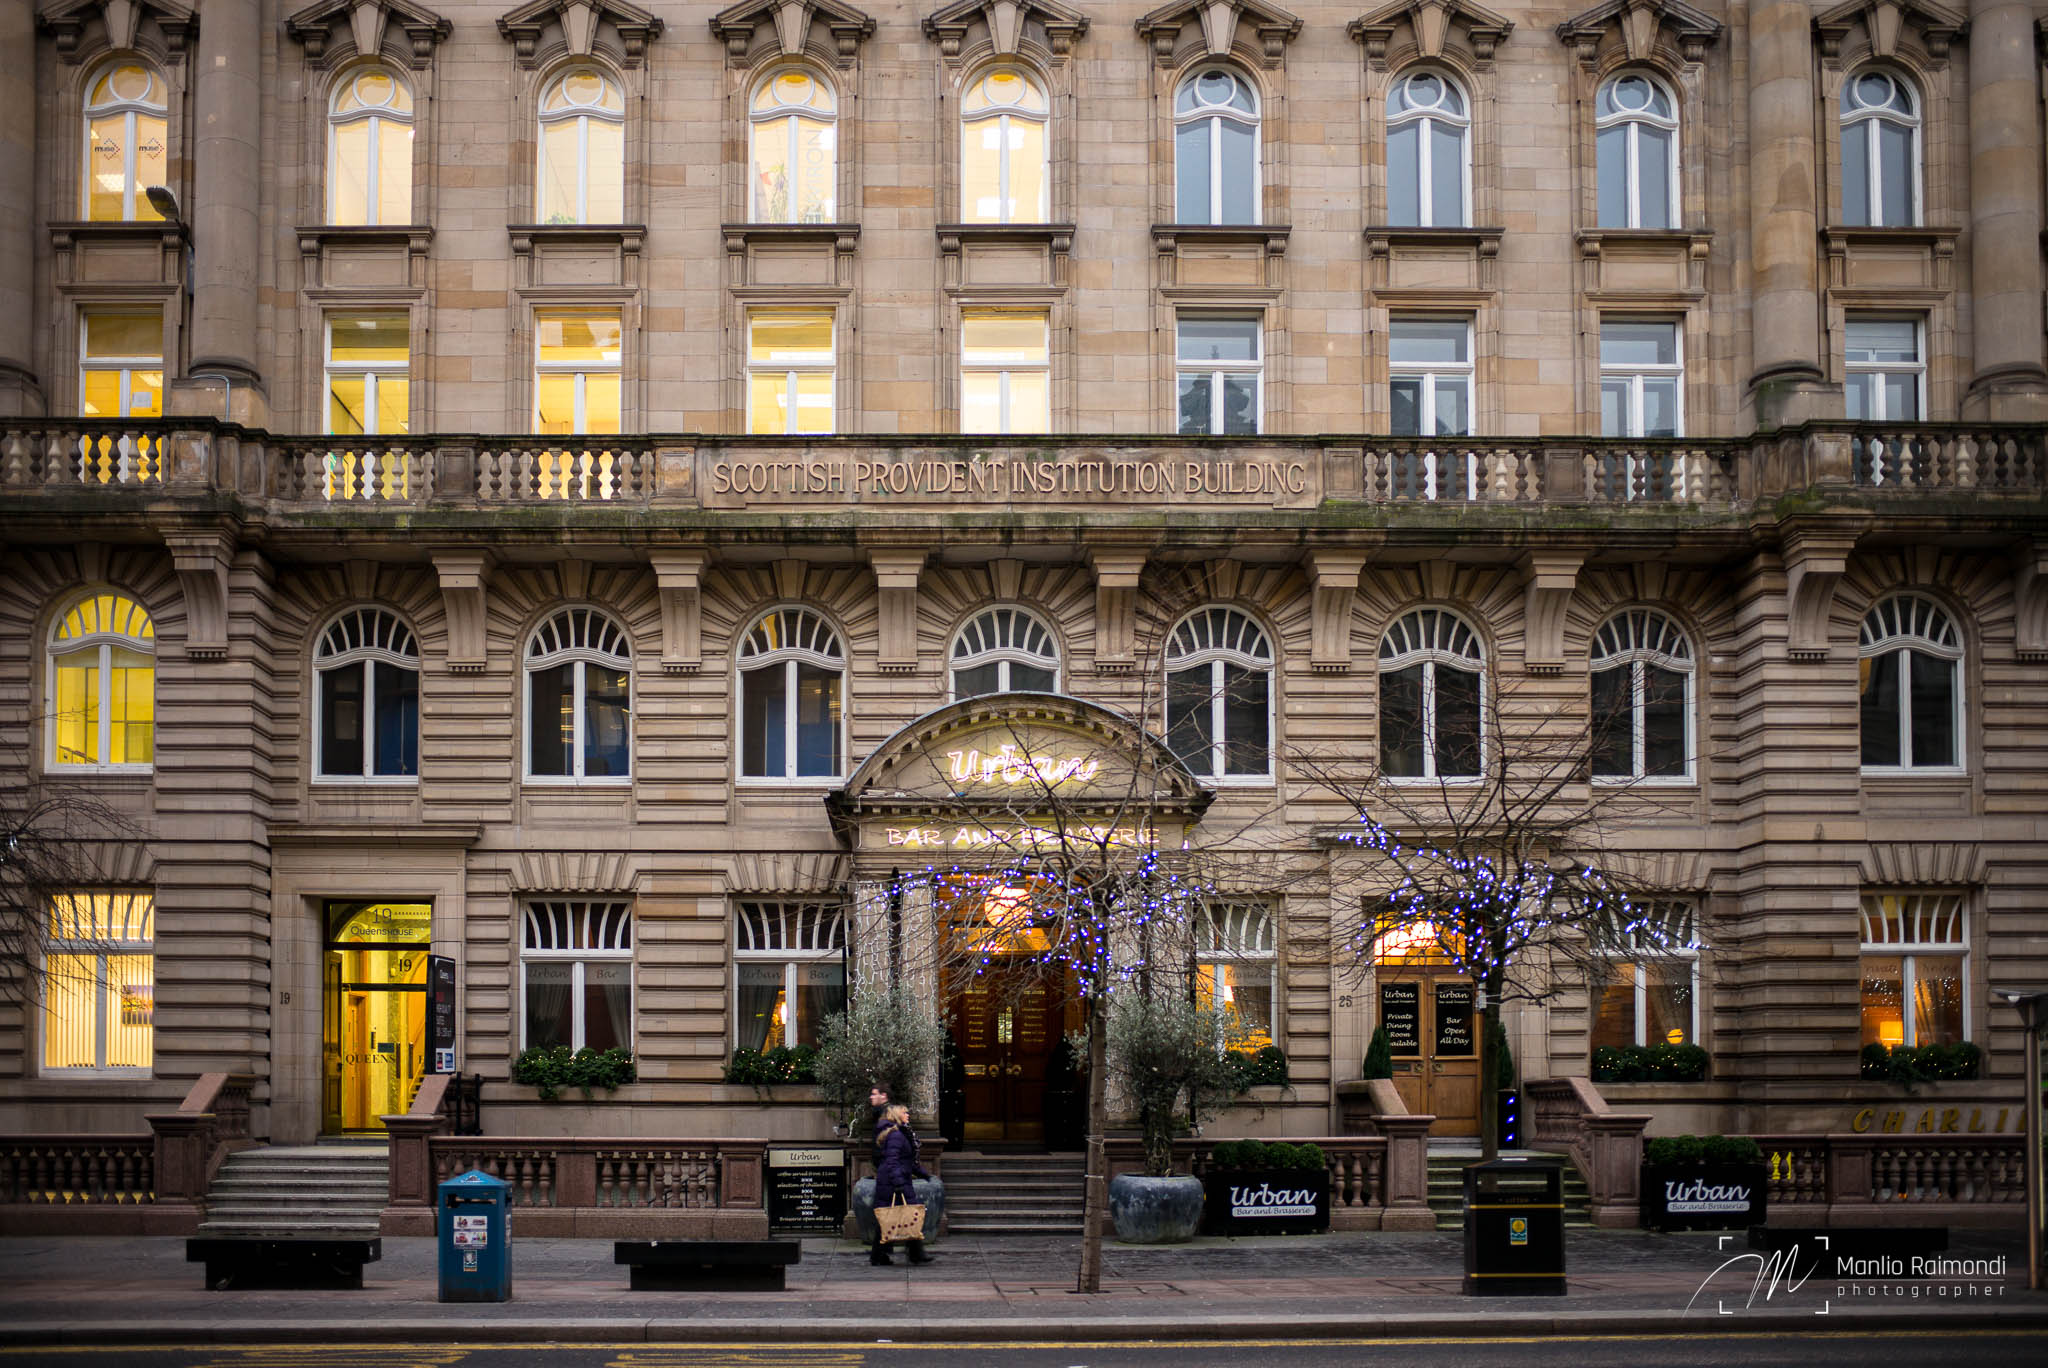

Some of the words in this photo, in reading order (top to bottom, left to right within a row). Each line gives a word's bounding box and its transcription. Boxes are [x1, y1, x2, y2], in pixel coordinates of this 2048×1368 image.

[713, 462, 845, 494] SCOTTISH
[854, 462, 1004, 494] PROVIDENT
[1012, 462, 1176, 494] INSTITUTION
[1185, 462, 1305, 494] BUILDING
[948, 745, 1098, 783] Urban
[886, 828, 944, 846] BAR
[952, 828, 1011, 845] AND
[372, 908, 392, 924] 19
[399, 958, 412, 973] 19
[528, 967, 569, 979] Urban
[280, 991, 291, 1005] 19
[1338, 994, 1353, 1008] 25
[1384, 990, 1415, 999] Urban
[1444, 1027, 1466, 1036] Open
[1453, 1037, 1470, 1046] Day
[345, 1054, 396, 1065] QUEENS
[790, 1152, 821, 1161] Urban
[1230, 1183, 1318, 1206] Urban
[1665, 1178, 1751, 1201] Urban
[1236, 1208, 1253, 1216] Bar
[1253, 1207, 1273, 1215] and
[1671, 1203, 1688, 1211] Bar
[1688, 1202, 1707, 1210] and
